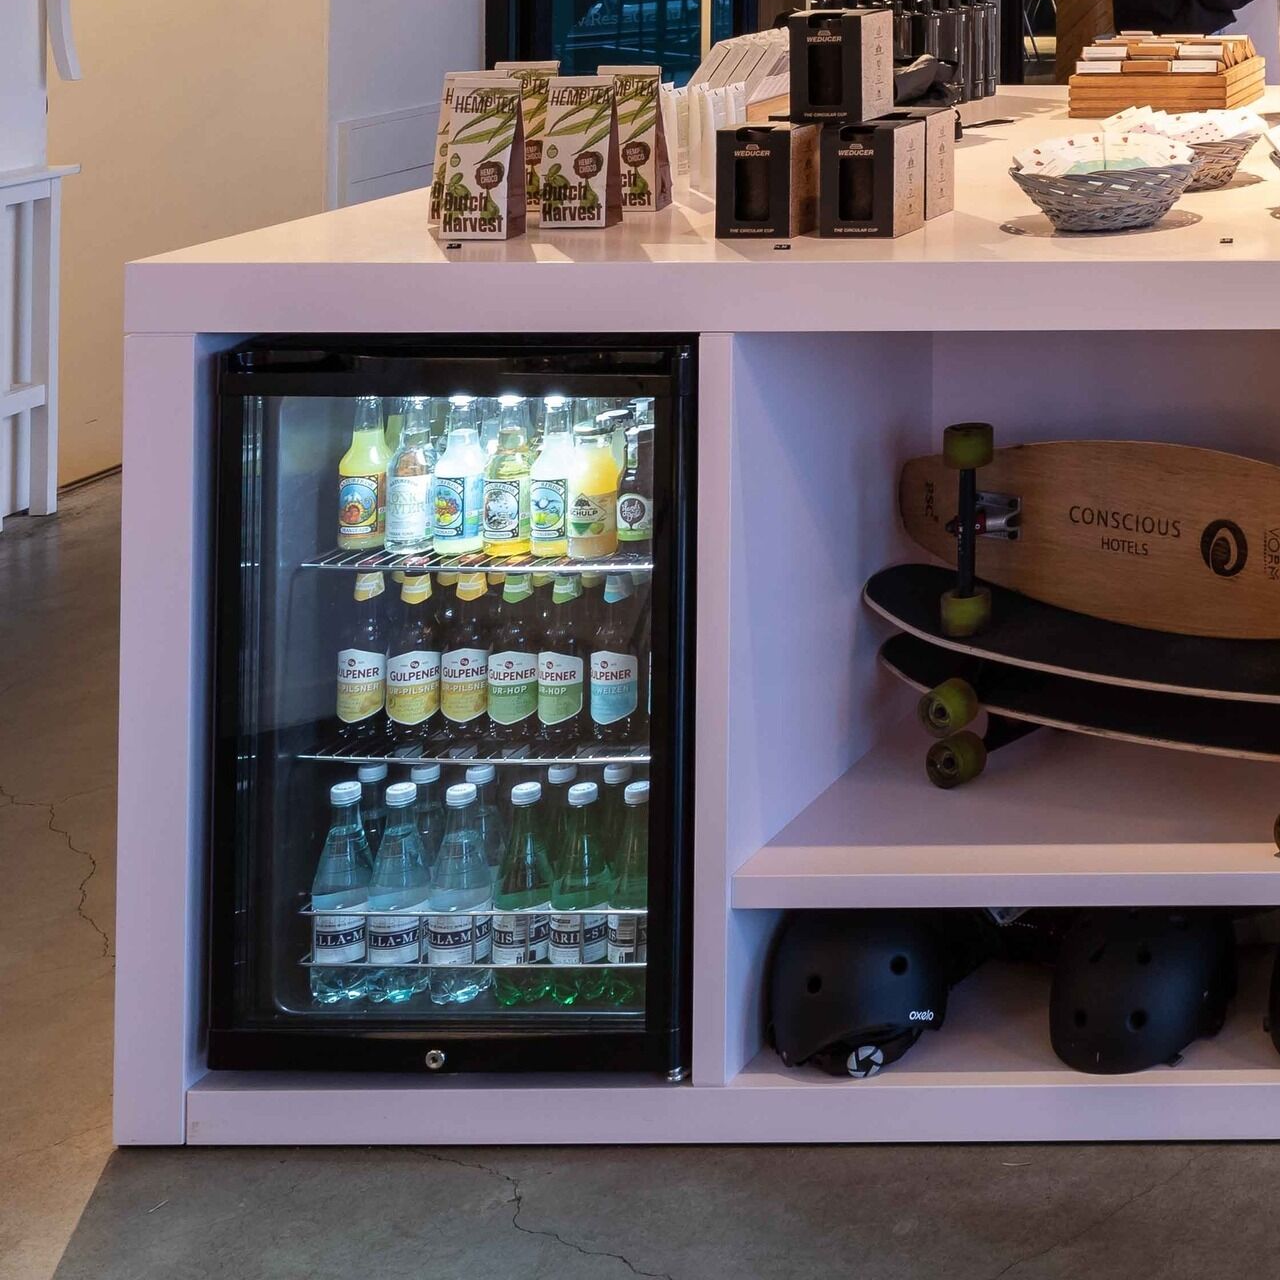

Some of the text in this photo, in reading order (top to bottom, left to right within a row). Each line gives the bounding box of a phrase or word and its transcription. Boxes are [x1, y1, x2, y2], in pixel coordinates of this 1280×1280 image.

[806, 35, 842, 43] WEDUCER
[551, 87, 612, 106] HEMP TEA
[633, 78, 655, 97] TEA
[455, 94, 516, 114] HEMP TEA
[480, 168, 494, 176] HEMP
[579, 165, 597, 173] CHOCO
[480, 175, 498, 183] CHOCO
[444, 191, 488, 213] Dutch
[542, 182, 587, 203] Dutch
[542, 202, 603, 222] Harvest
[442, 211, 504, 233] Harvest
[1069, 505, 1181, 538] CONSCIOUS
[1101, 537, 1148, 556] HOTELS
[1267, 527, 1280, 580] VORM
[488, 667, 536, 681] GULPENER
[492, 685, 527, 695] UR-HOP
[909, 1010, 934, 1020] oxelo
